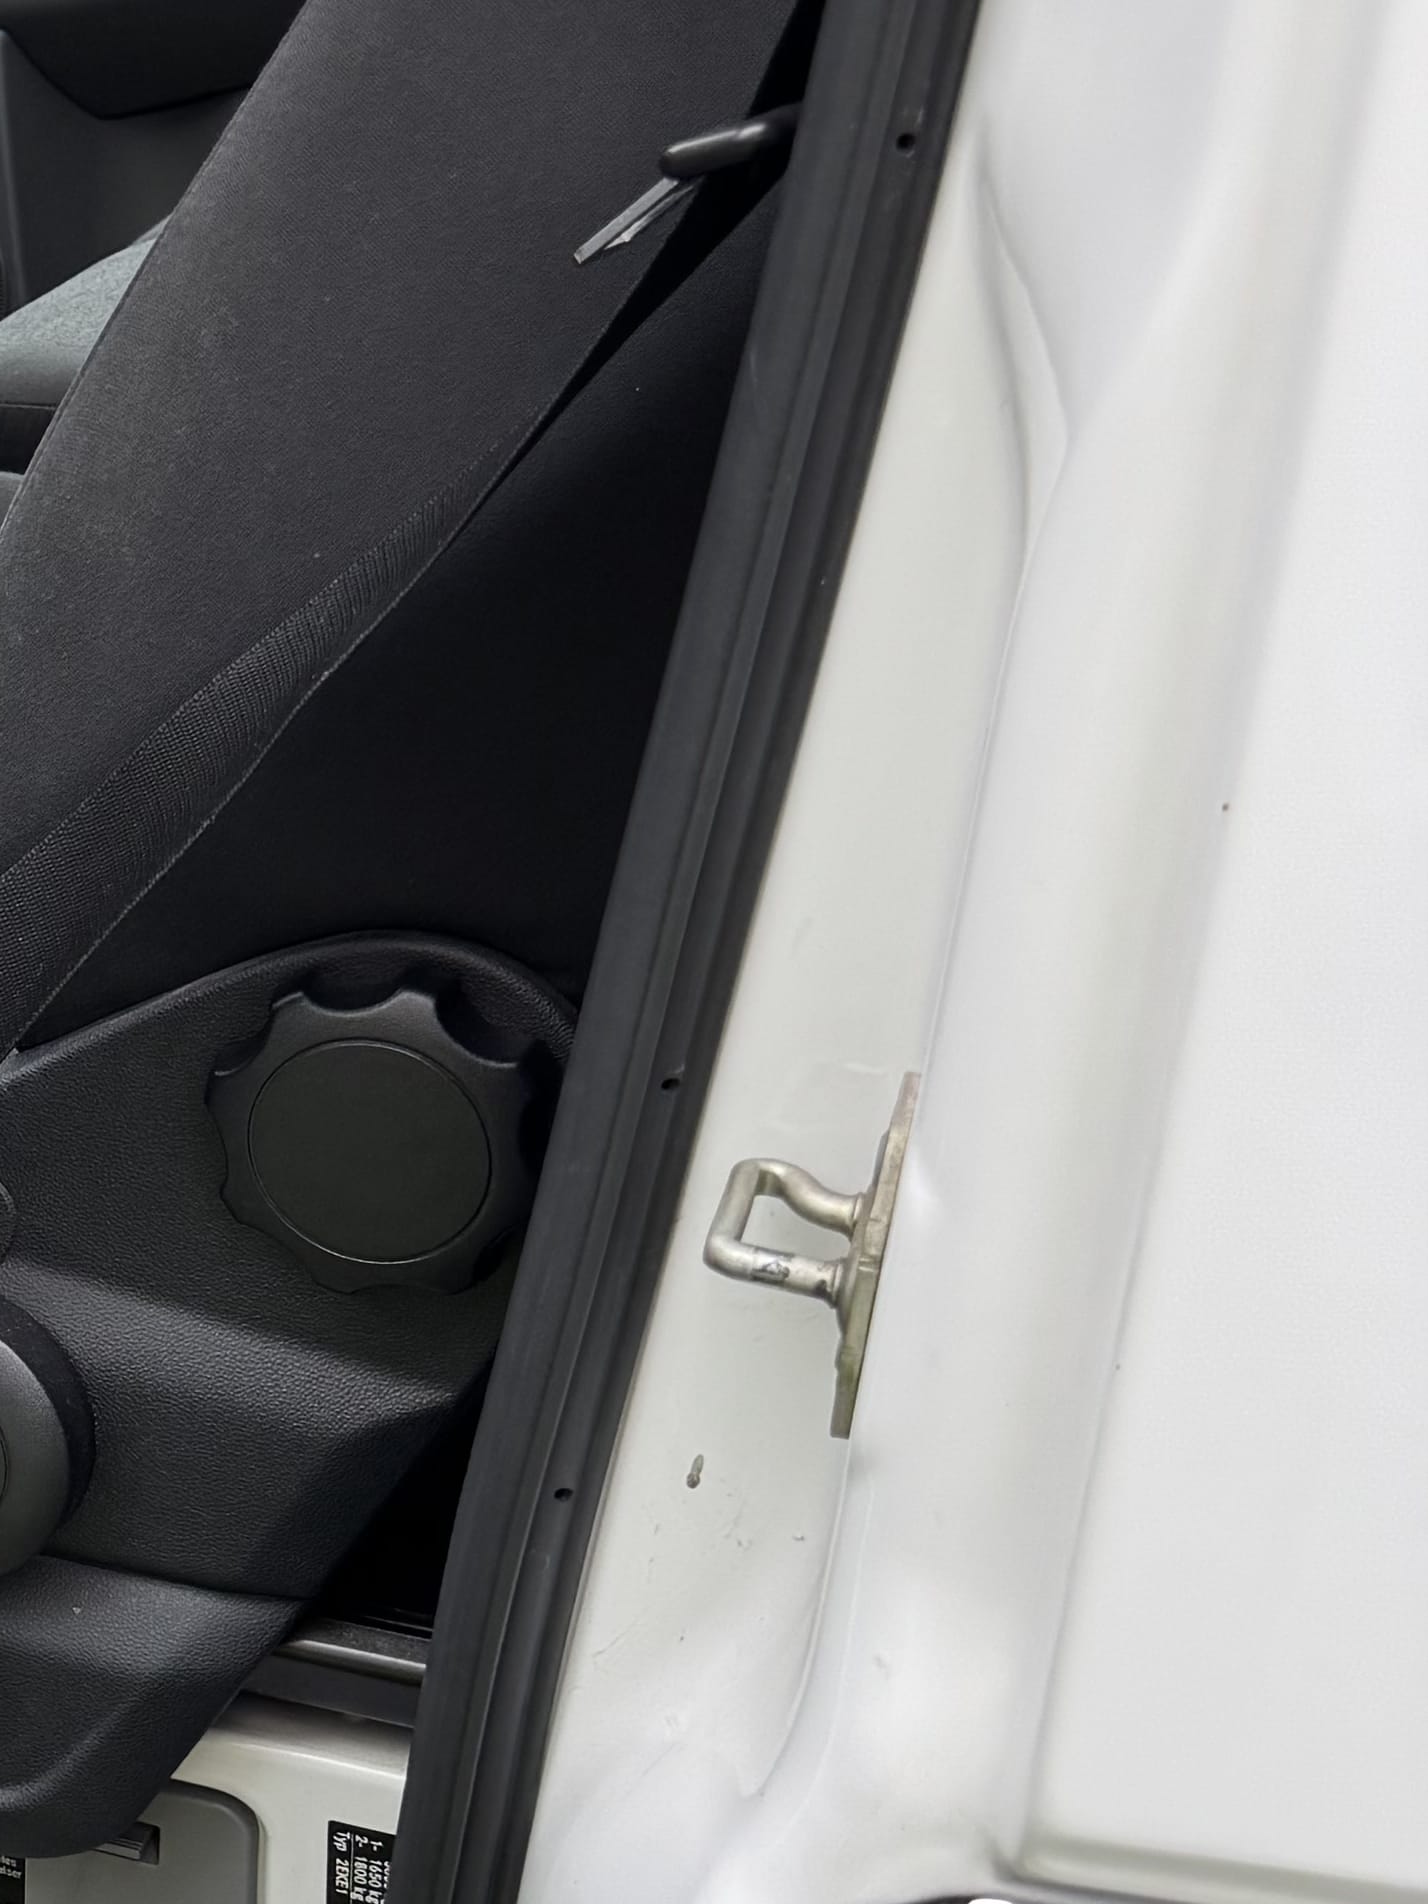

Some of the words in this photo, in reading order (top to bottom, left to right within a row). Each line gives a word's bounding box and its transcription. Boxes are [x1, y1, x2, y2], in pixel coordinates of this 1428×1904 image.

[332, 1832, 351, 1852] Typ
[353, 1856, 368, 1885] 1800
[368, 1859, 383, 1888] 1650
[350, 1886, 367, 1902] kg
